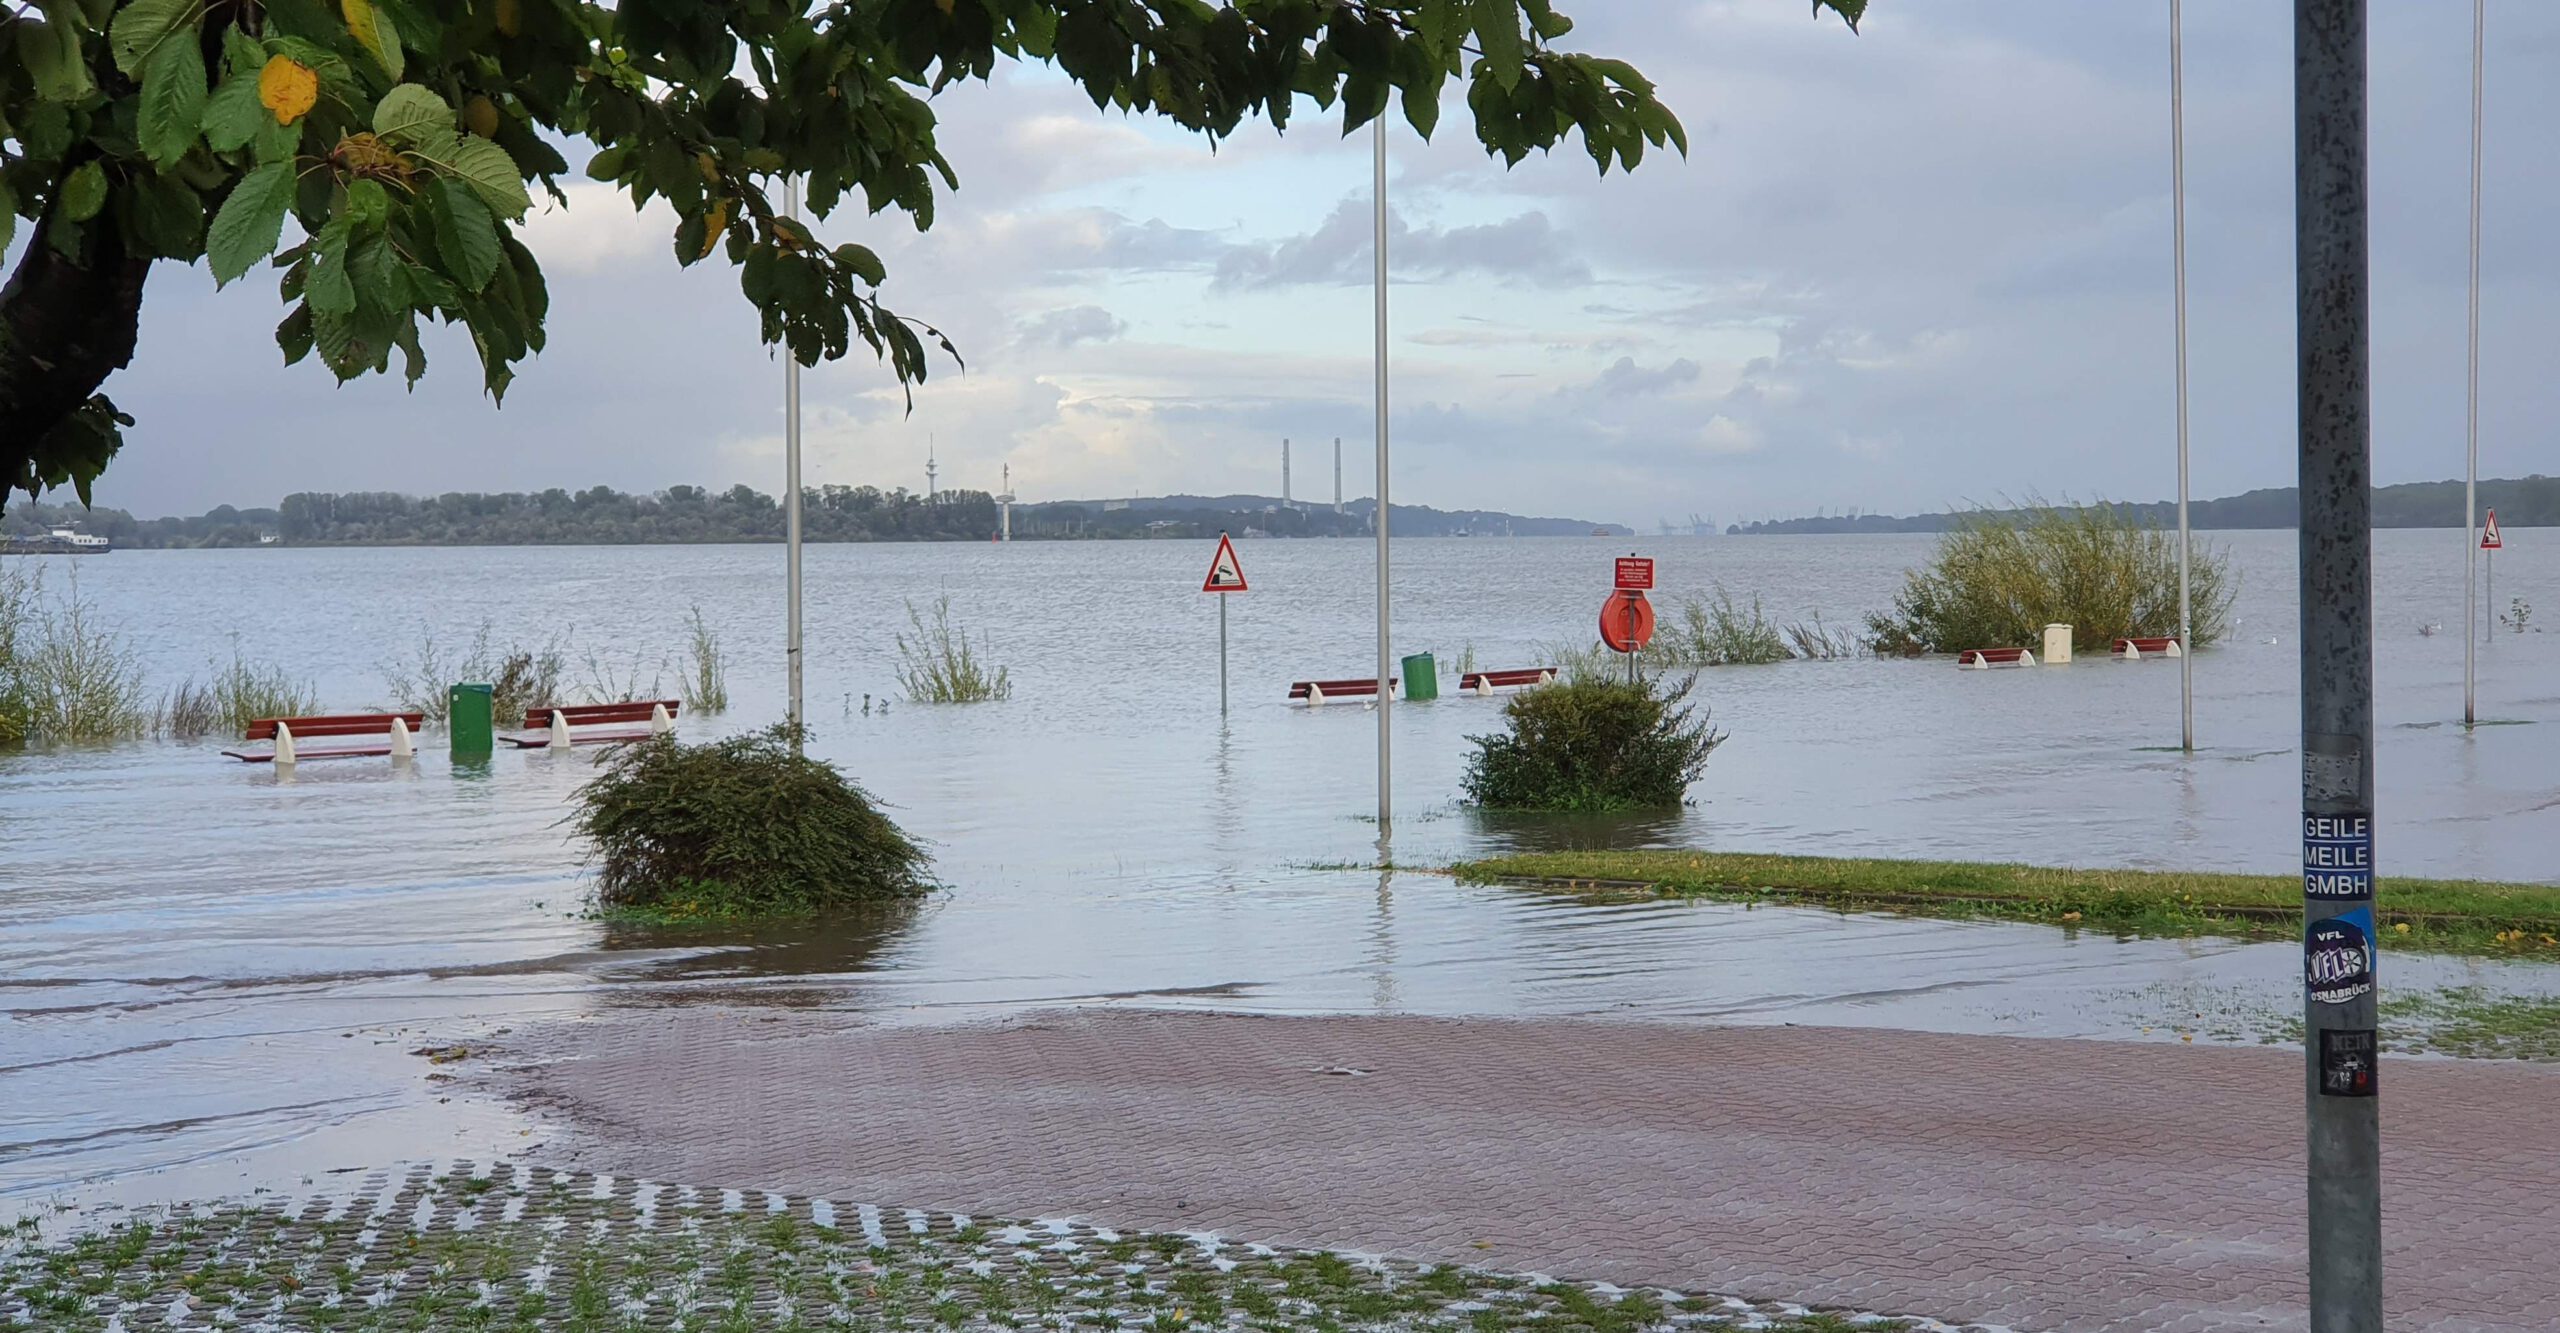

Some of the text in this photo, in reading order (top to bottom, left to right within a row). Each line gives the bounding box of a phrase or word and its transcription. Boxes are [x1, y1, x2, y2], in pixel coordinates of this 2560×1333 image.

[2304, 818, 2367, 838] GEILE
[2305, 846, 2367, 866] MEILE
[2305, 875, 2367, 895] GMBH
[2317, 930, 2345, 942] VFL
[2311, 984, 2371, 1001] OSNABRÜCK
